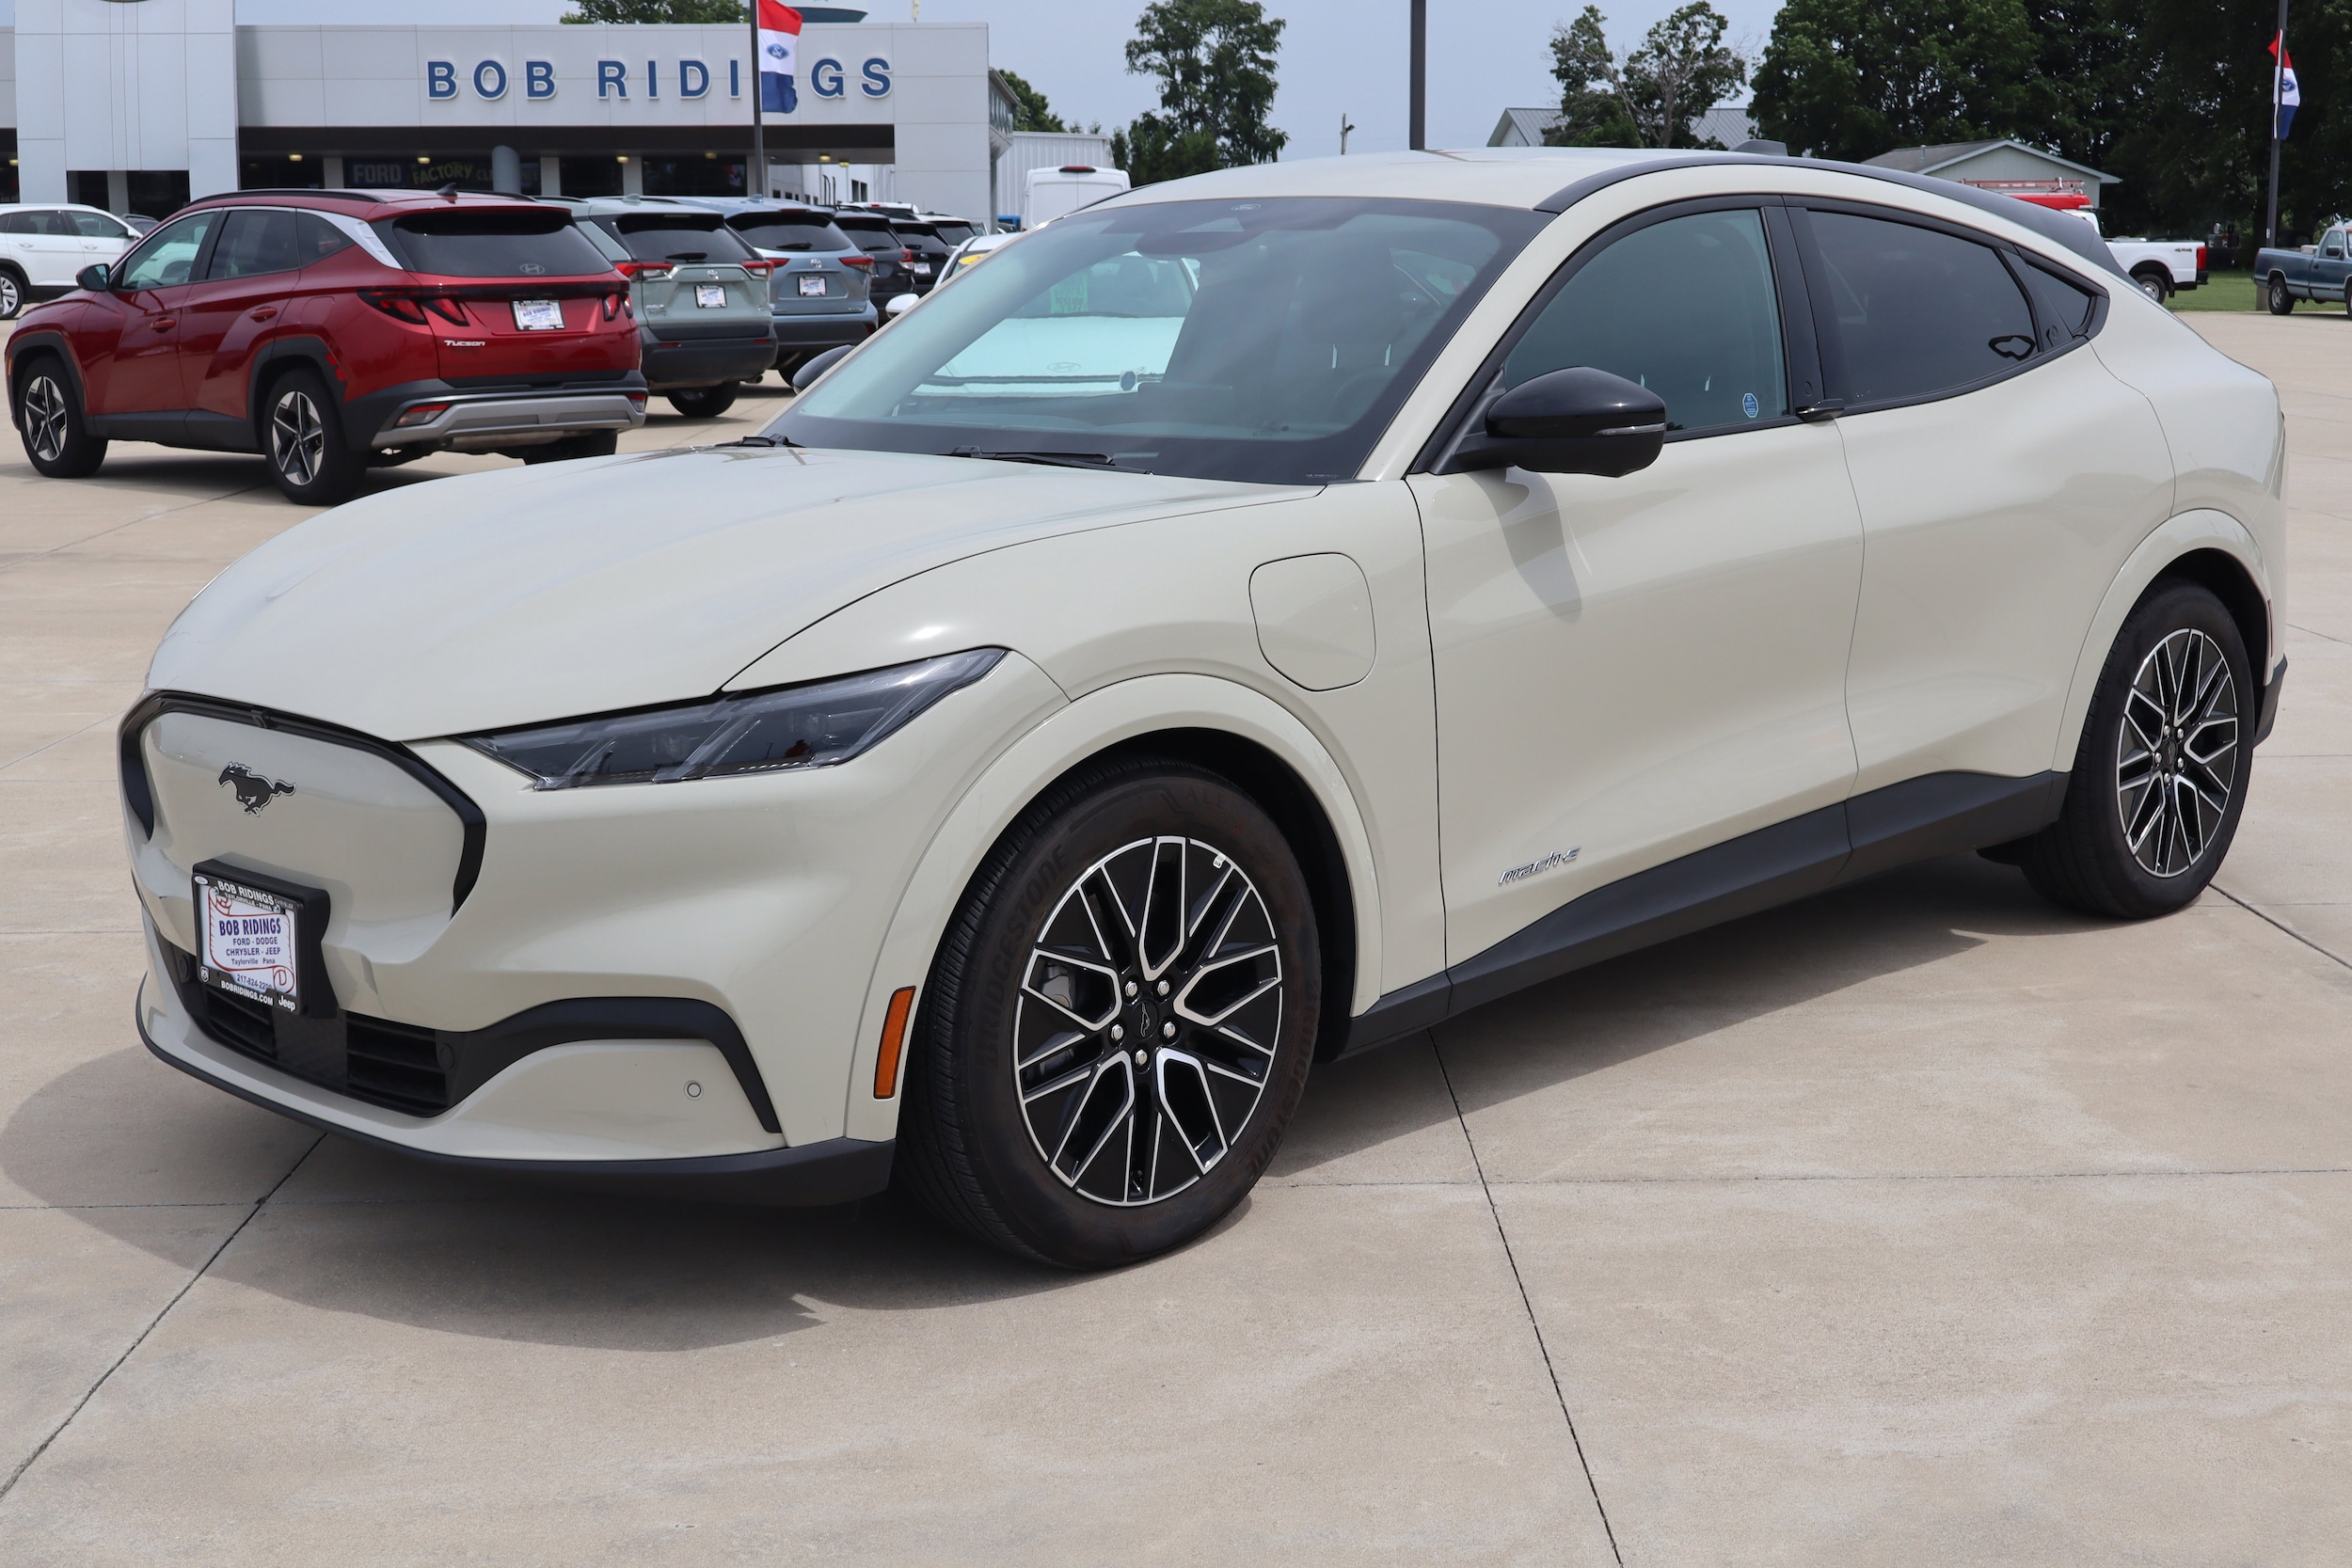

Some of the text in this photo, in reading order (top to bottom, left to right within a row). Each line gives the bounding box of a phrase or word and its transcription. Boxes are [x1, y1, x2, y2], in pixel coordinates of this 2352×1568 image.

[426, 56, 893, 101] BOB RIDIGS
[353, 164, 402, 183] FORD
[412, 163, 474, 185] FACTORY
[217, 880, 275, 906] BOB RIDINGS
[219, 917, 281, 936] BOB RIDINGS
[255, 936, 278, 945] DODGE
[226, 947, 260, 957] CHRYSLER
[265, 946, 280, 956] JEEP
[230, 958, 259, 966] Taylorville
[220, 980, 274, 1006] BOBRIDINGS.COM
[278, 996, 295, 1012] Jeep
